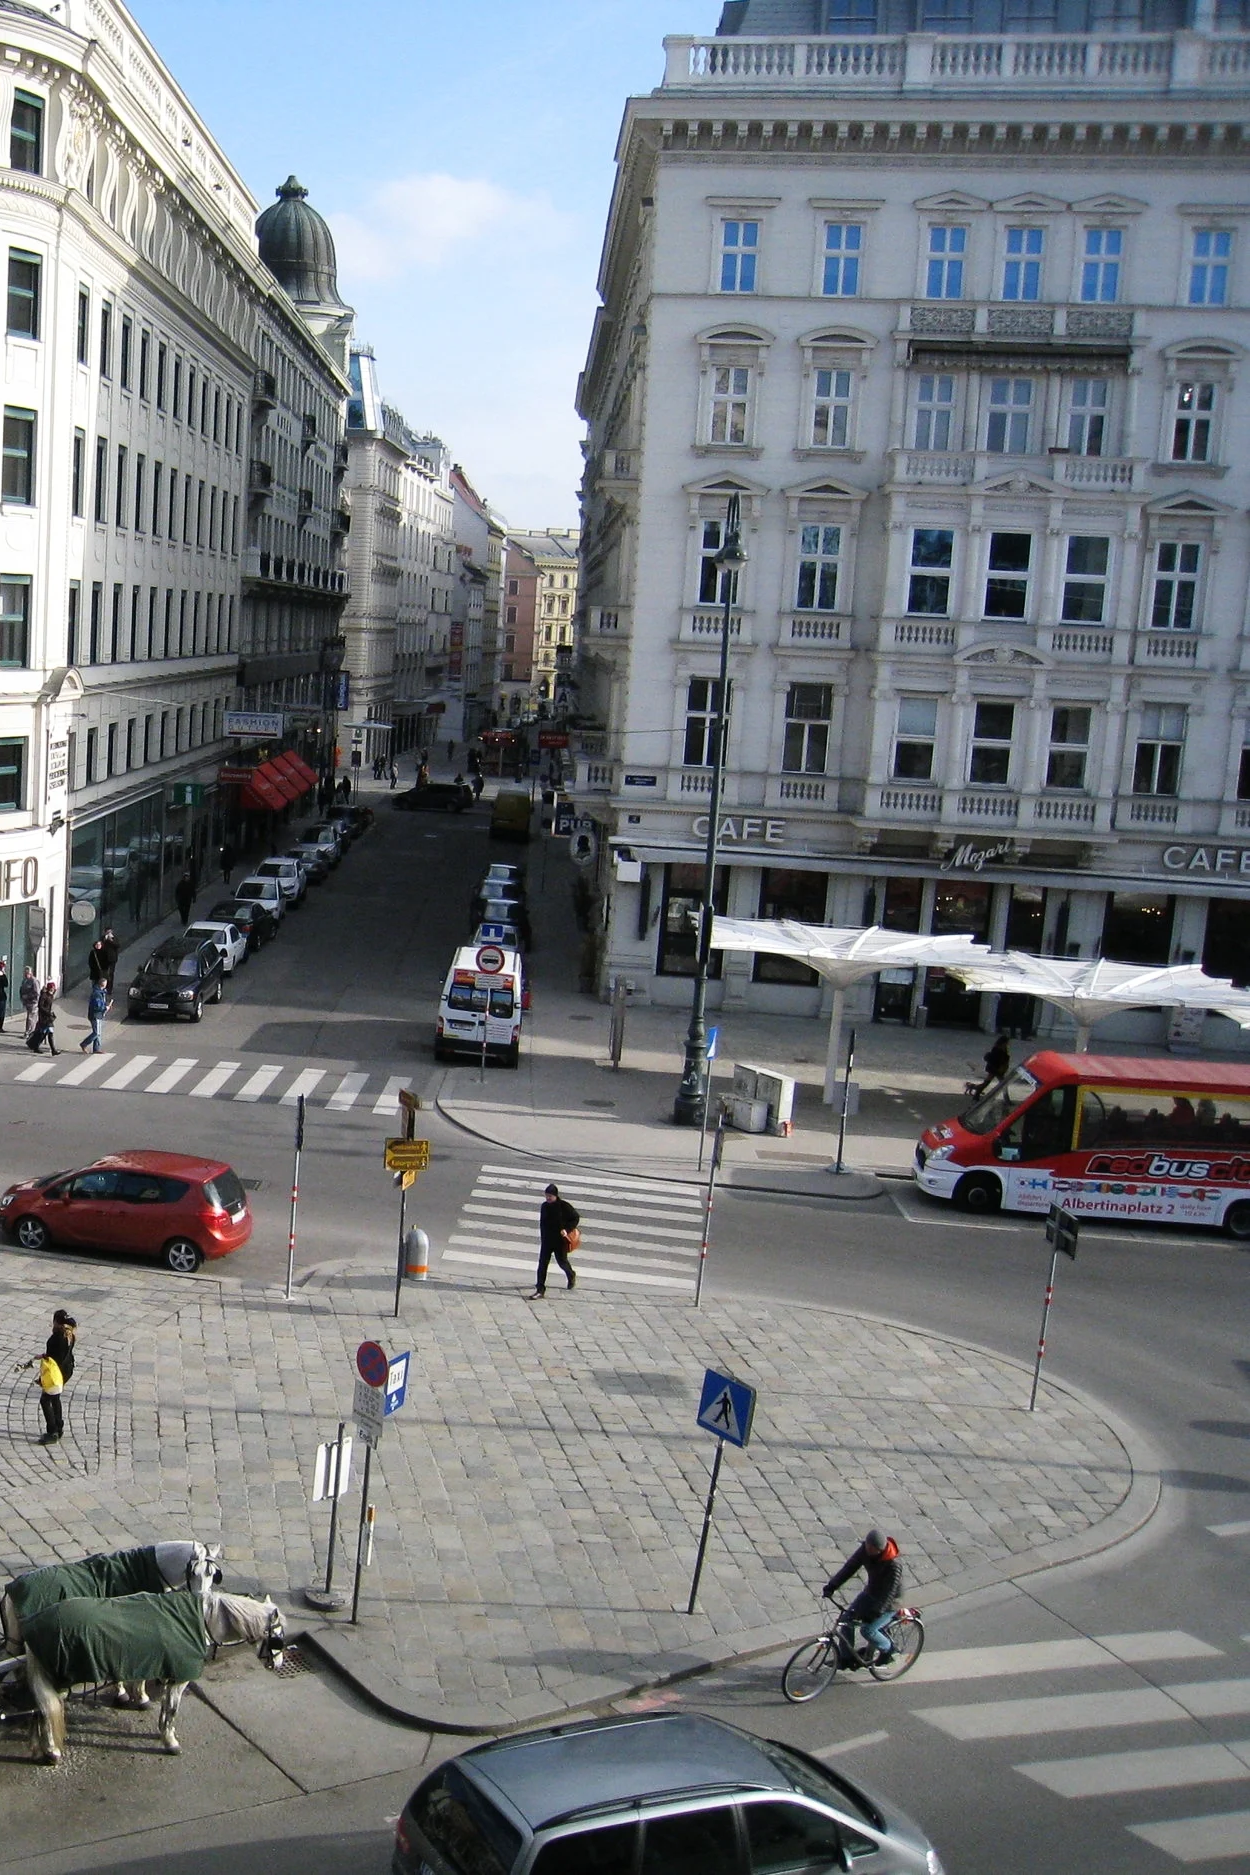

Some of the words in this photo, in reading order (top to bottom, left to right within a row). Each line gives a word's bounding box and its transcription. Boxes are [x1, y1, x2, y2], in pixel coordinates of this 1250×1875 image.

[228, 717, 279, 727] FASHION
[692, 815, 787, 844] CAFE
[939, 838, 1014, 872] Mozart
[1061, 1197, 1163, 1216] Albertinaplatz
[1166, 1203, 1175, 1215] 2
[389, 1370, 404, 1386] Taxi
